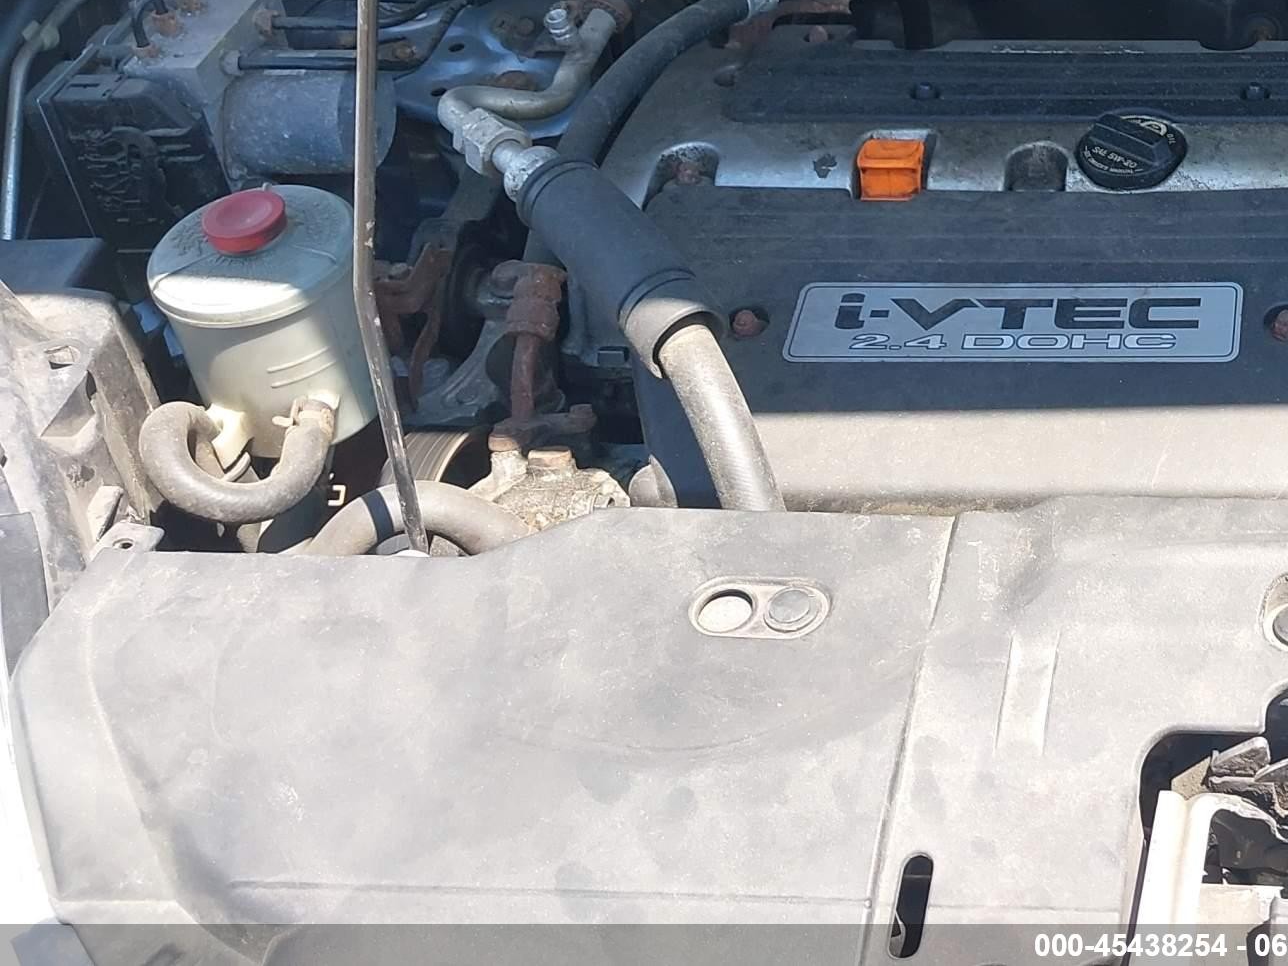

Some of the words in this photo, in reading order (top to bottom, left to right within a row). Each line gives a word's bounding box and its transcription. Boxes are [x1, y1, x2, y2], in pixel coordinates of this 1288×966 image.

[834, 292, 1202, 331] i-VTEC
[848, 333, 947, 351] 2.4
[960, 333, 1177, 351] DOHC
